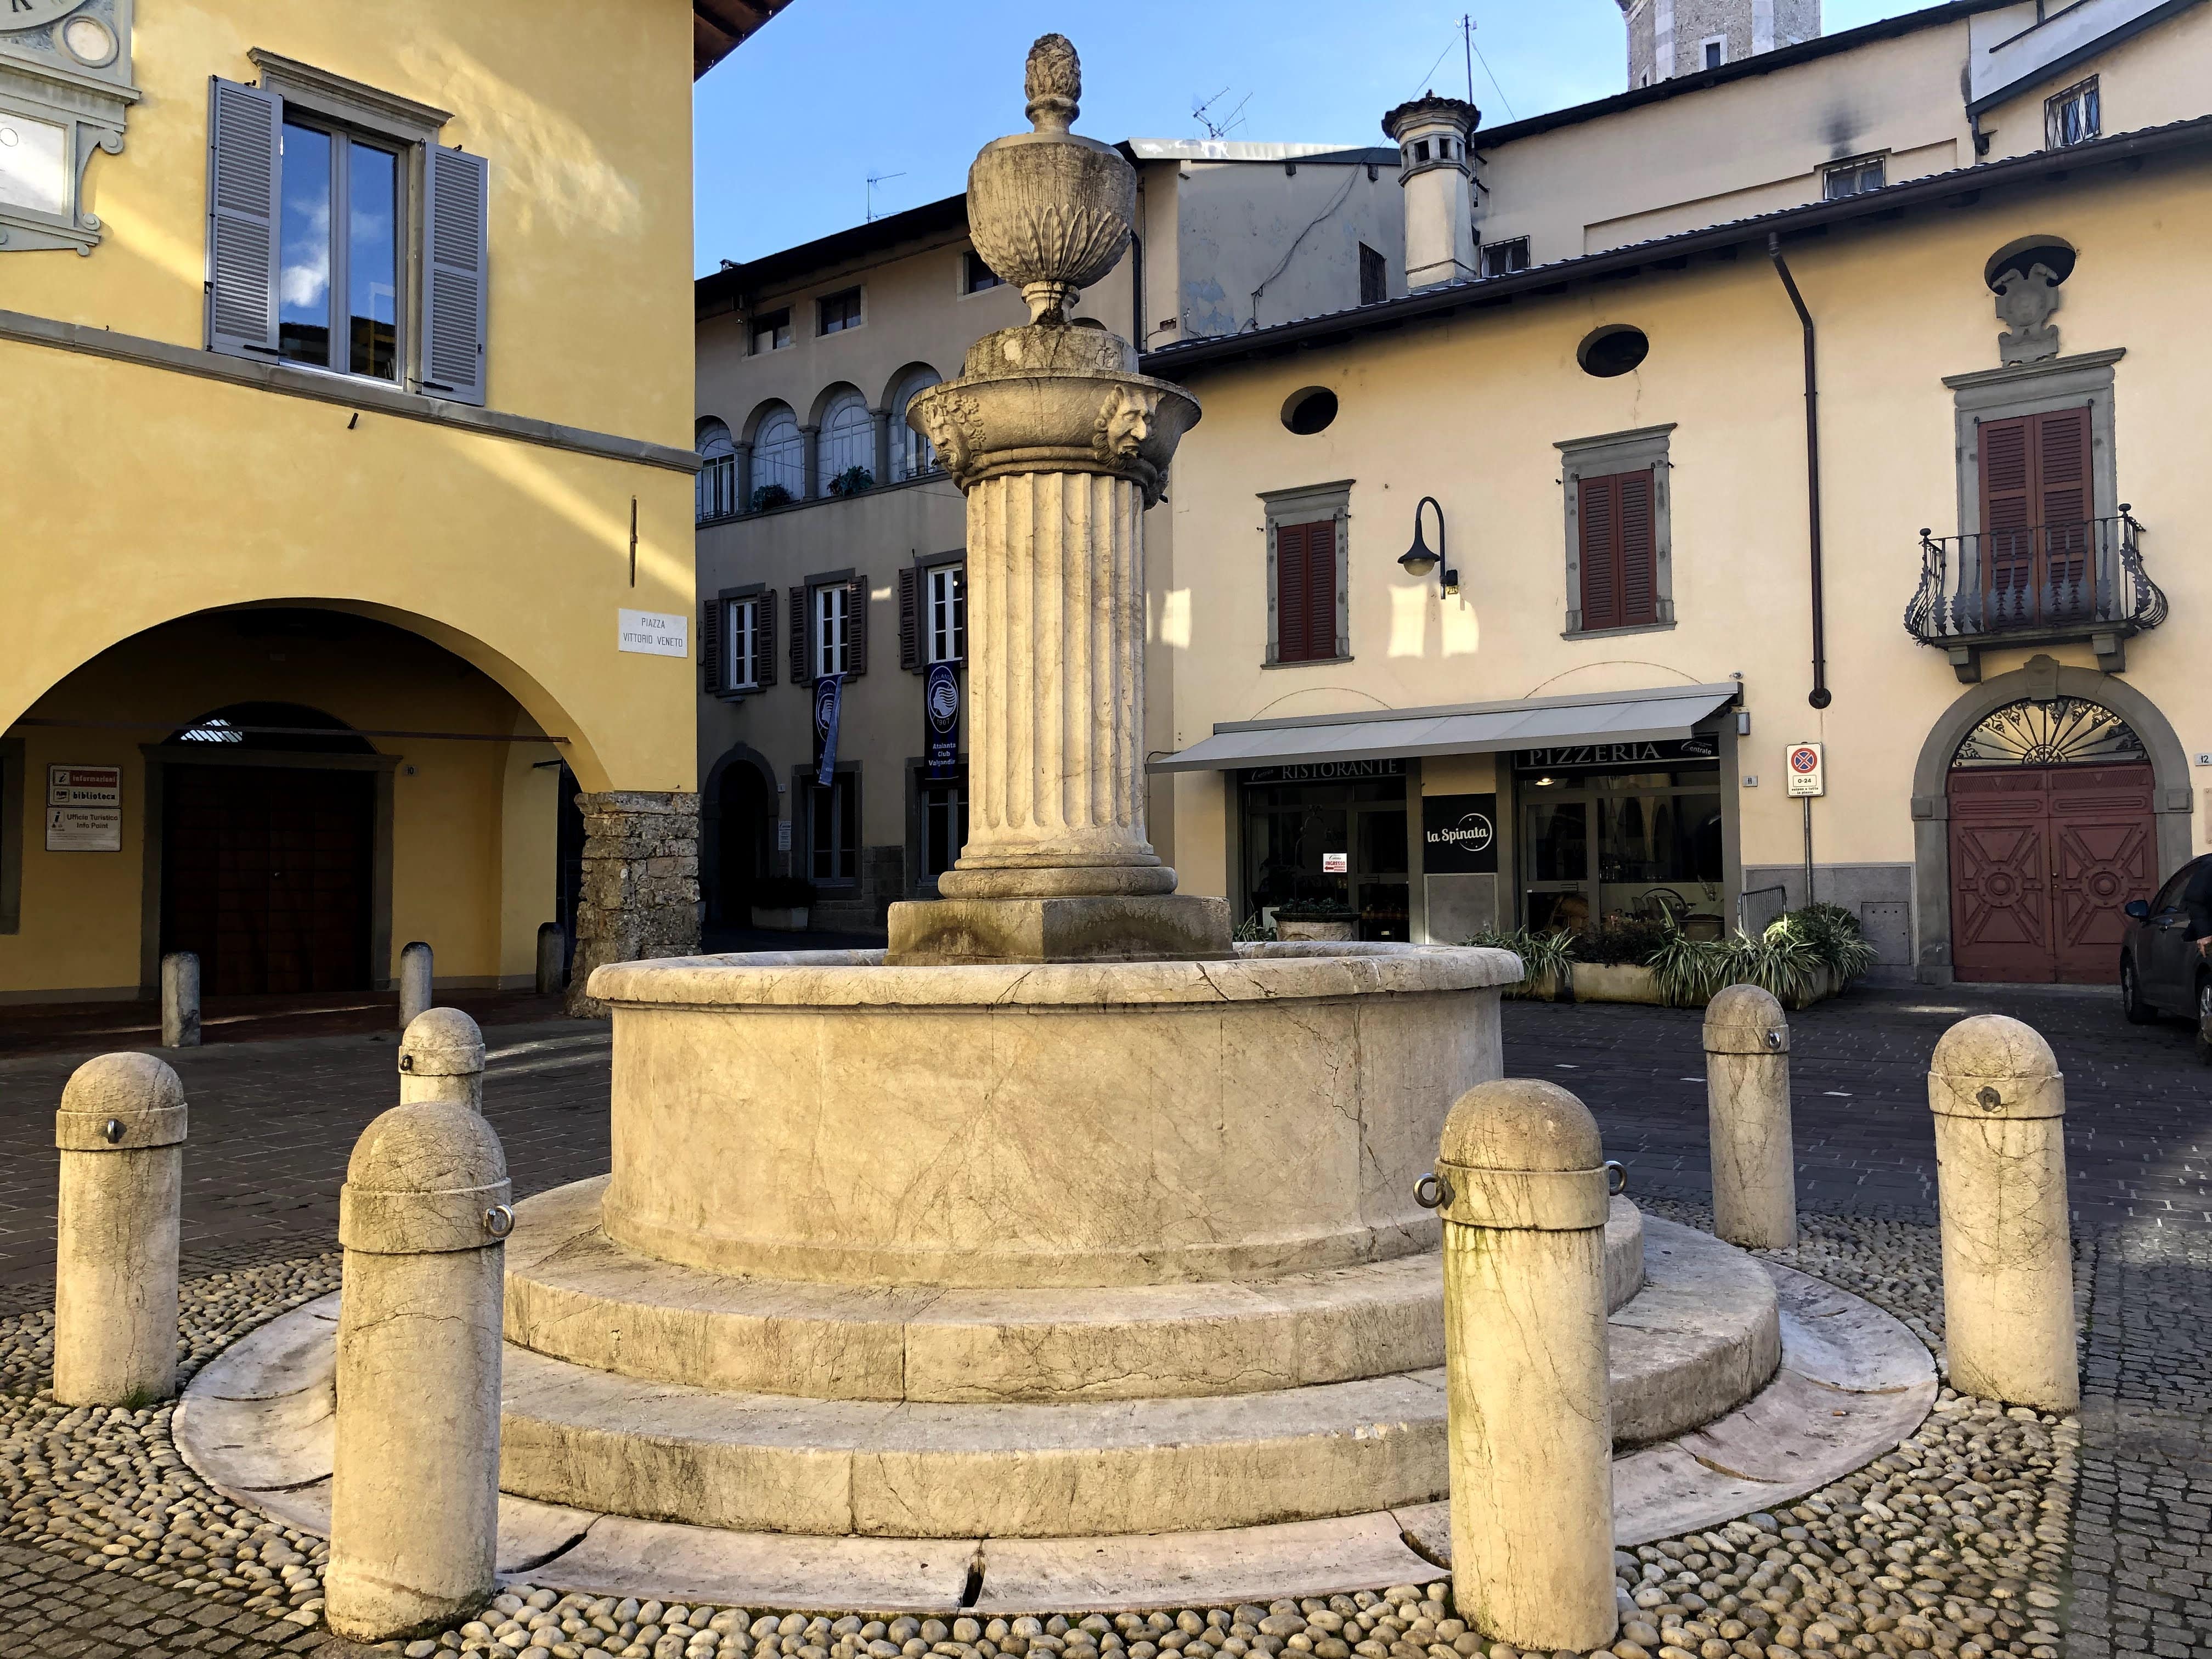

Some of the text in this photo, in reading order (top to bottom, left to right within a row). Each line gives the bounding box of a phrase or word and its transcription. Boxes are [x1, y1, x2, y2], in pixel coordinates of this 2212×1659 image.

[641, 617, 665, 629] PIAZZA
[623, 632, 683, 647] VITTORIO VENETO
[1530, 742, 1662, 766] PIZZERIA
[2200, 755, 2209, 763] 12
[1282, 758, 1397, 779] RISTORANTE
[72, 774, 116, 782] informazioni
[73, 791, 116, 800] biblioteca
[1427, 827, 1488, 844] la Spinata
